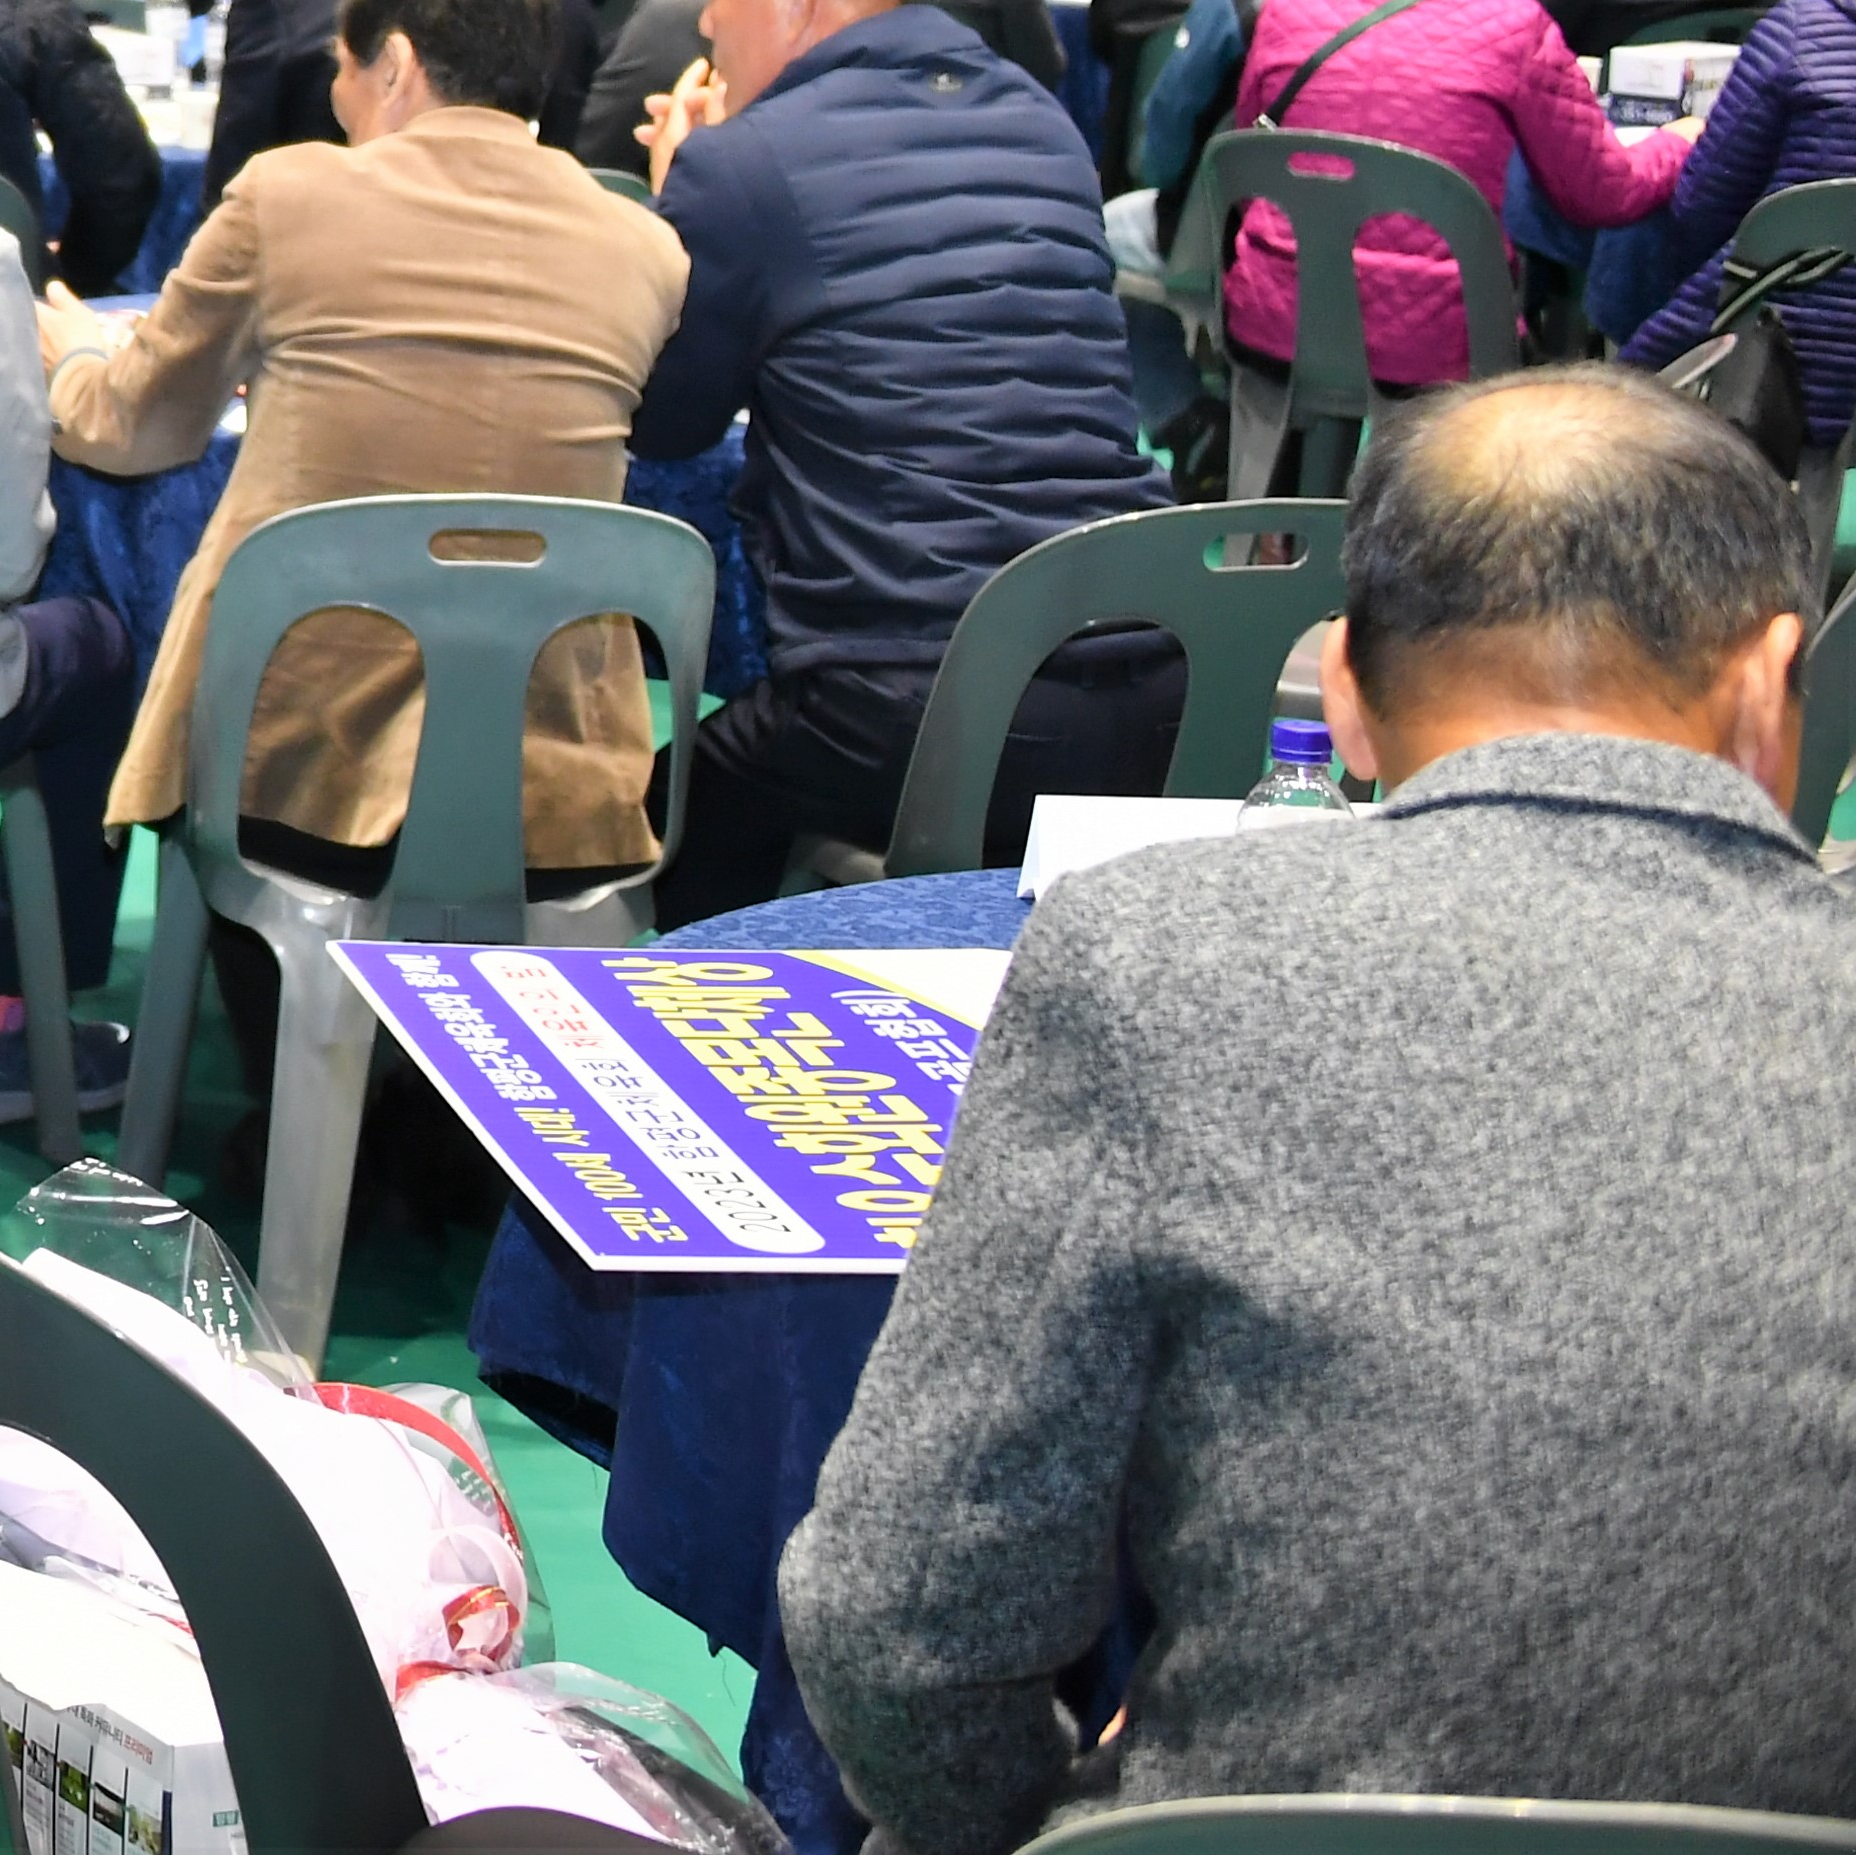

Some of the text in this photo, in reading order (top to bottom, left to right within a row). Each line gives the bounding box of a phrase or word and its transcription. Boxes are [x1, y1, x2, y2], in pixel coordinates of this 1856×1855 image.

[517, 987, 606, 1050] 체육인의
[384, 952, 690, 1244] 군민 100세 시대! 함평군체육회와 함께!
[574, 1056, 721, 1162] 함평군체육회
[680, 1169, 793, 1235] 2023년
